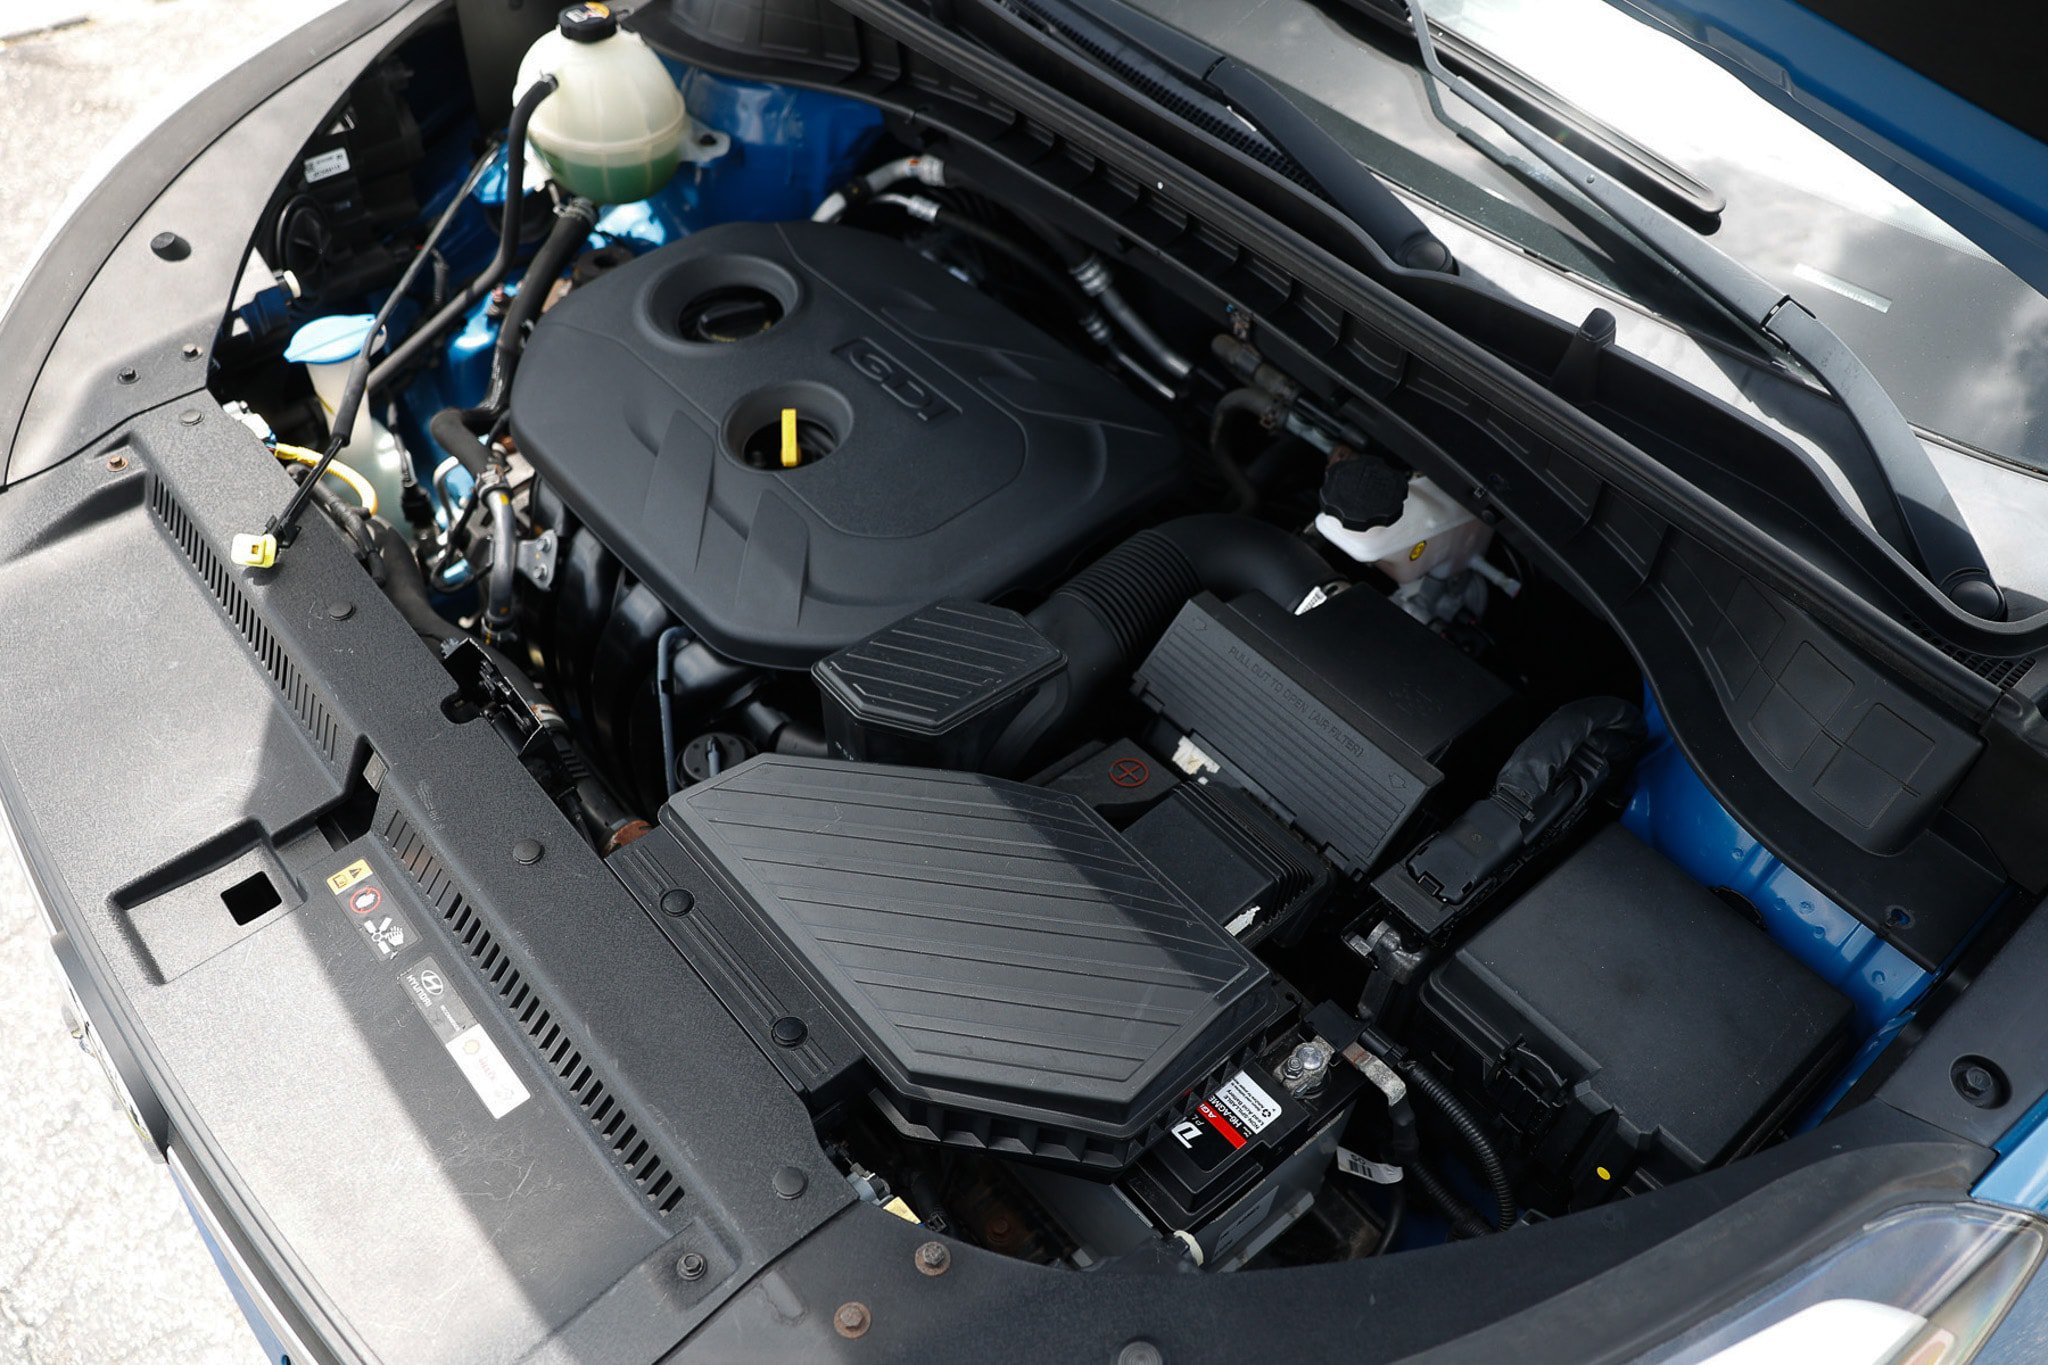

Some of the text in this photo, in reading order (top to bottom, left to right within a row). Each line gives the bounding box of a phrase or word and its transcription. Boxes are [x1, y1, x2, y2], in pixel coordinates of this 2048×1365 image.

[850, 351, 947, 421] GDI
[1229, 646, 1249, 667] PULL
[1250, 663, 1271, 682] OUT
[1270, 677, 1284, 692] TO
[1282, 687, 1308, 713] OPEN
[406, 974, 432, 1007] HYUNDAI
[1223, 1094, 1259, 1129] NON-SPILLABLE
[1226, 1089, 1263, 1125] Lead Acid Battery
